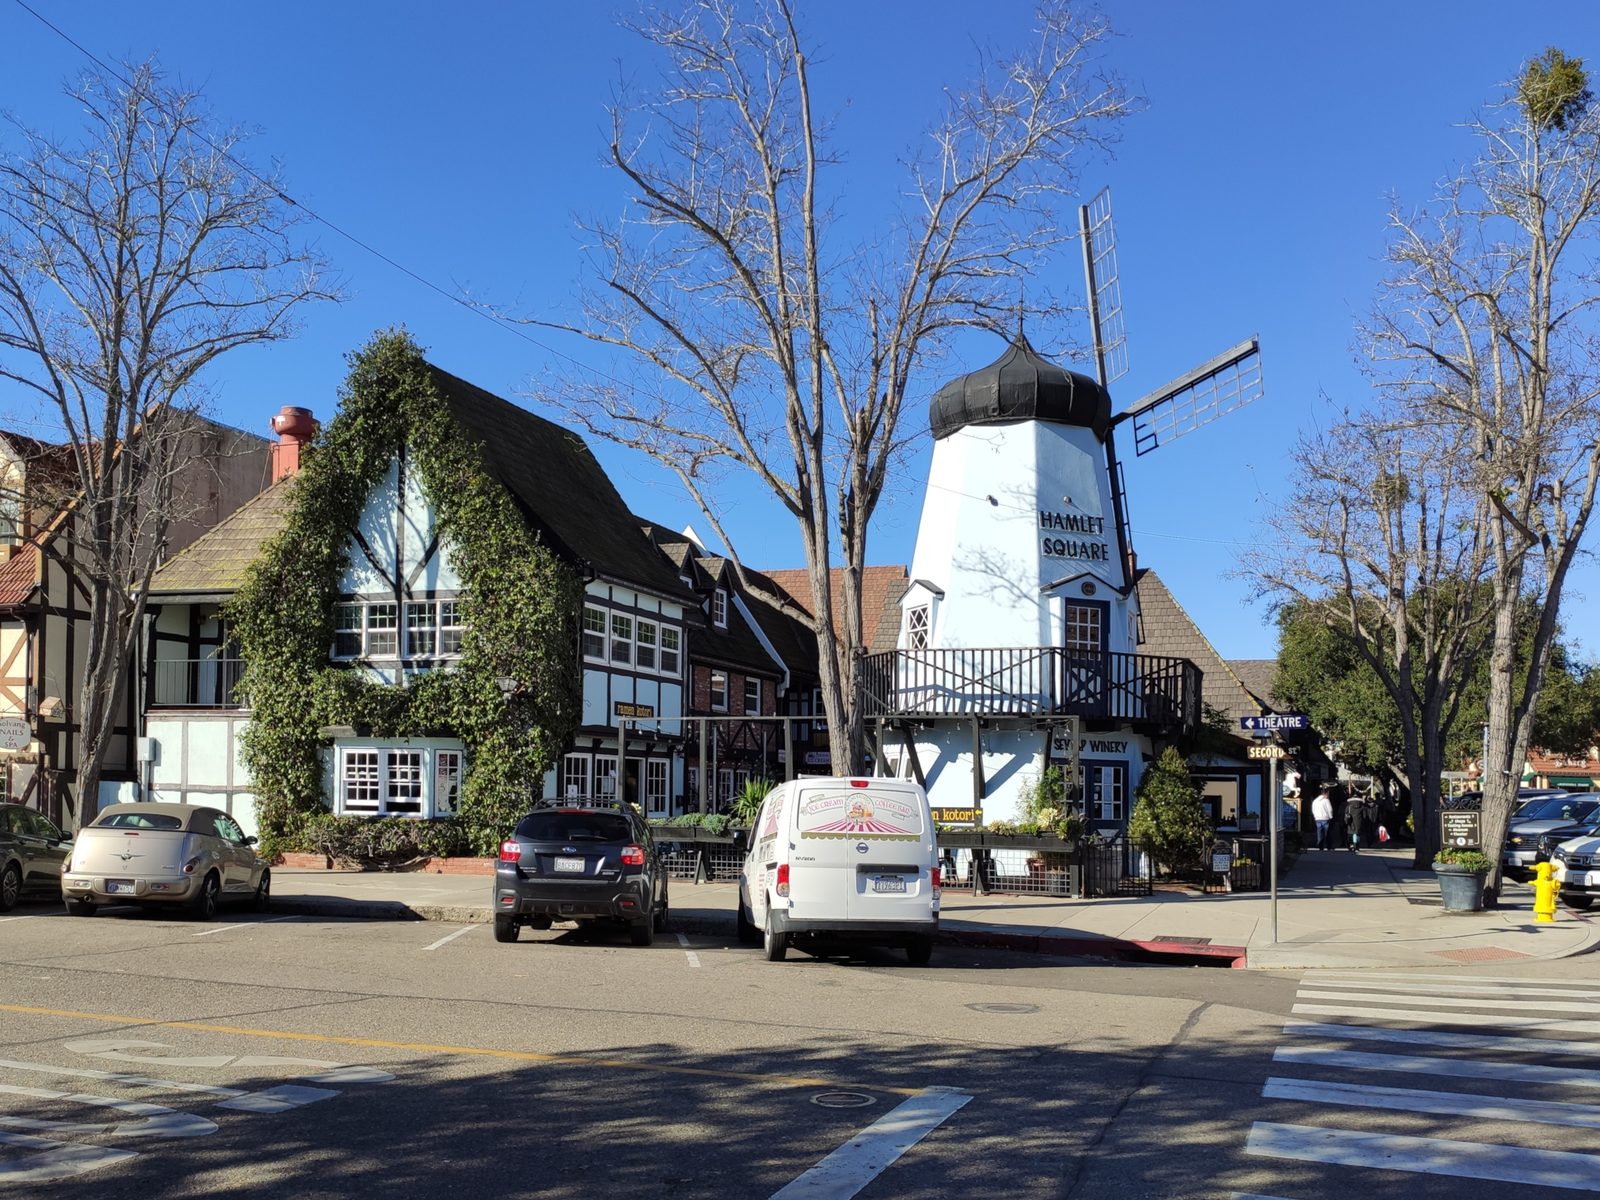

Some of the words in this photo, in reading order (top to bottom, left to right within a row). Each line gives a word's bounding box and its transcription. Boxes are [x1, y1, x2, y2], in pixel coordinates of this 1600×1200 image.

[1040, 510, 1104, 534] HAMLET
[1043, 537, 1109, 561] SQUARE
[1257, 716, 1302, 729] THEATRE
[1089, 740, 1129, 754] WINERY
[1249, 746, 1284, 759] SECOND
[820, 798, 844, 808] CREAM
[874, 799, 896, 809] COFFEE
[942, 808, 976, 821] kotori
